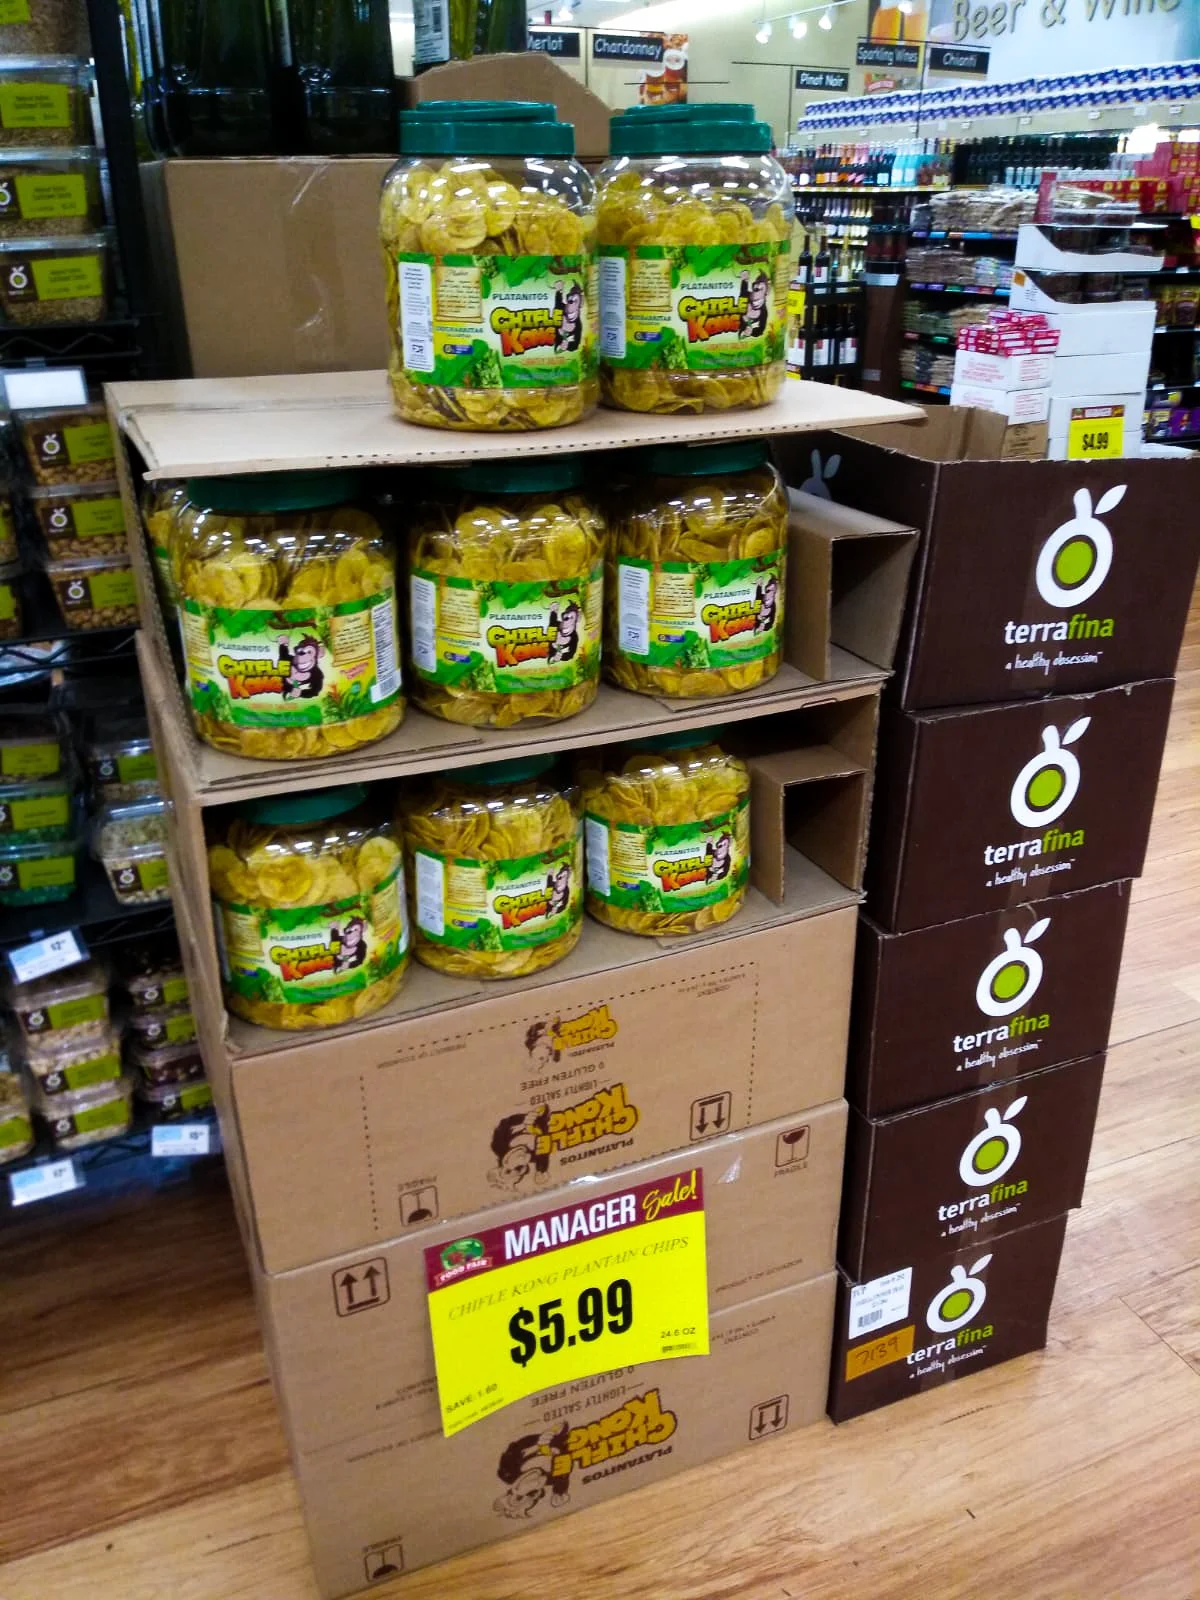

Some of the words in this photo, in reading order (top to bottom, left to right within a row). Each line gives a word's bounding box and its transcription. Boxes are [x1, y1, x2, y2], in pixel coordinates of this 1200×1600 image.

[951, 0, 1026, 42] Beer
[595, 38, 663, 61] Chardonnay
[857, 45, 895, 66] Sparkling
[895, 49, 919, 64] Wines
[942, 52, 978, 68] Chianti
[800, 72, 824, 87] Pinot
[826, 74, 846, 88] Noir
[492, 292, 549, 301] PLATANITOS
[681, 282, 735, 290] PLATANITOS
[490, 306, 564, 334] CHIFLE
[678, 295, 749, 321] CHIFLE
[1082, 432, 1109, 451] $4.99
[489, 613, 543, 621] PLATANITOS
[702, 599, 763, 625] CHIFLE
[487, 625, 559, 648] CHIFLE
[1004, 613, 1115, 644] terrafina
[217, 654, 291, 678] CHIFLE
[1014, 651, 1051, 676] healthy
[984, 829, 1085, 865] terrafina
[653, 854, 714, 878] CHIFLE
[994, 867, 1028, 887] healthy
[493, 887, 554, 914] CHIFLE
[269, 941, 342, 965] CHIFLE
[953, 1014, 1050, 1053] terrafina
[964, 1051, 996, 1069] healthy
[520, 1076, 549, 1092] FREE
[552, 1063, 596, 1083] GLUTEN
[530, 1089, 562, 1105] SALTED
[564, 1080, 597, 1096] LIGHTLY
[548, 1083, 626, 1133] KONG
[535, 1105, 638, 1155] CHIFLE
[560, 1138, 634, 1166] PLATANITOS
[937, 1180, 1028, 1221] terrafina
[504, 1193, 637, 1261] MANAGER
[642, 1170, 698, 1221] Sale!
[448, 1288, 507, 1320] CHIFLE
[511, 1272, 559, 1296] KONG
[563, 1247, 638, 1281] PLANTAIN
[641, 1236, 689, 1257] CHIPS
[508, 1278, 634, 1368] $5.99
[682, 1327, 696, 1335] OZ
[906, 1324, 994, 1365] terrafina
[570, 1368, 625, 1395] GLUTEN
[531, 1388, 567, 1409] FREE
[585, 1385, 627, 1409] LIGHTLY
[543, 1401, 582, 1423] SALTED
[566, 1387, 662, 1451] KONG
[551, 1411, 677, 1477] CHIFLE
[582, 1446, 672, 1486] PLATANITOS
